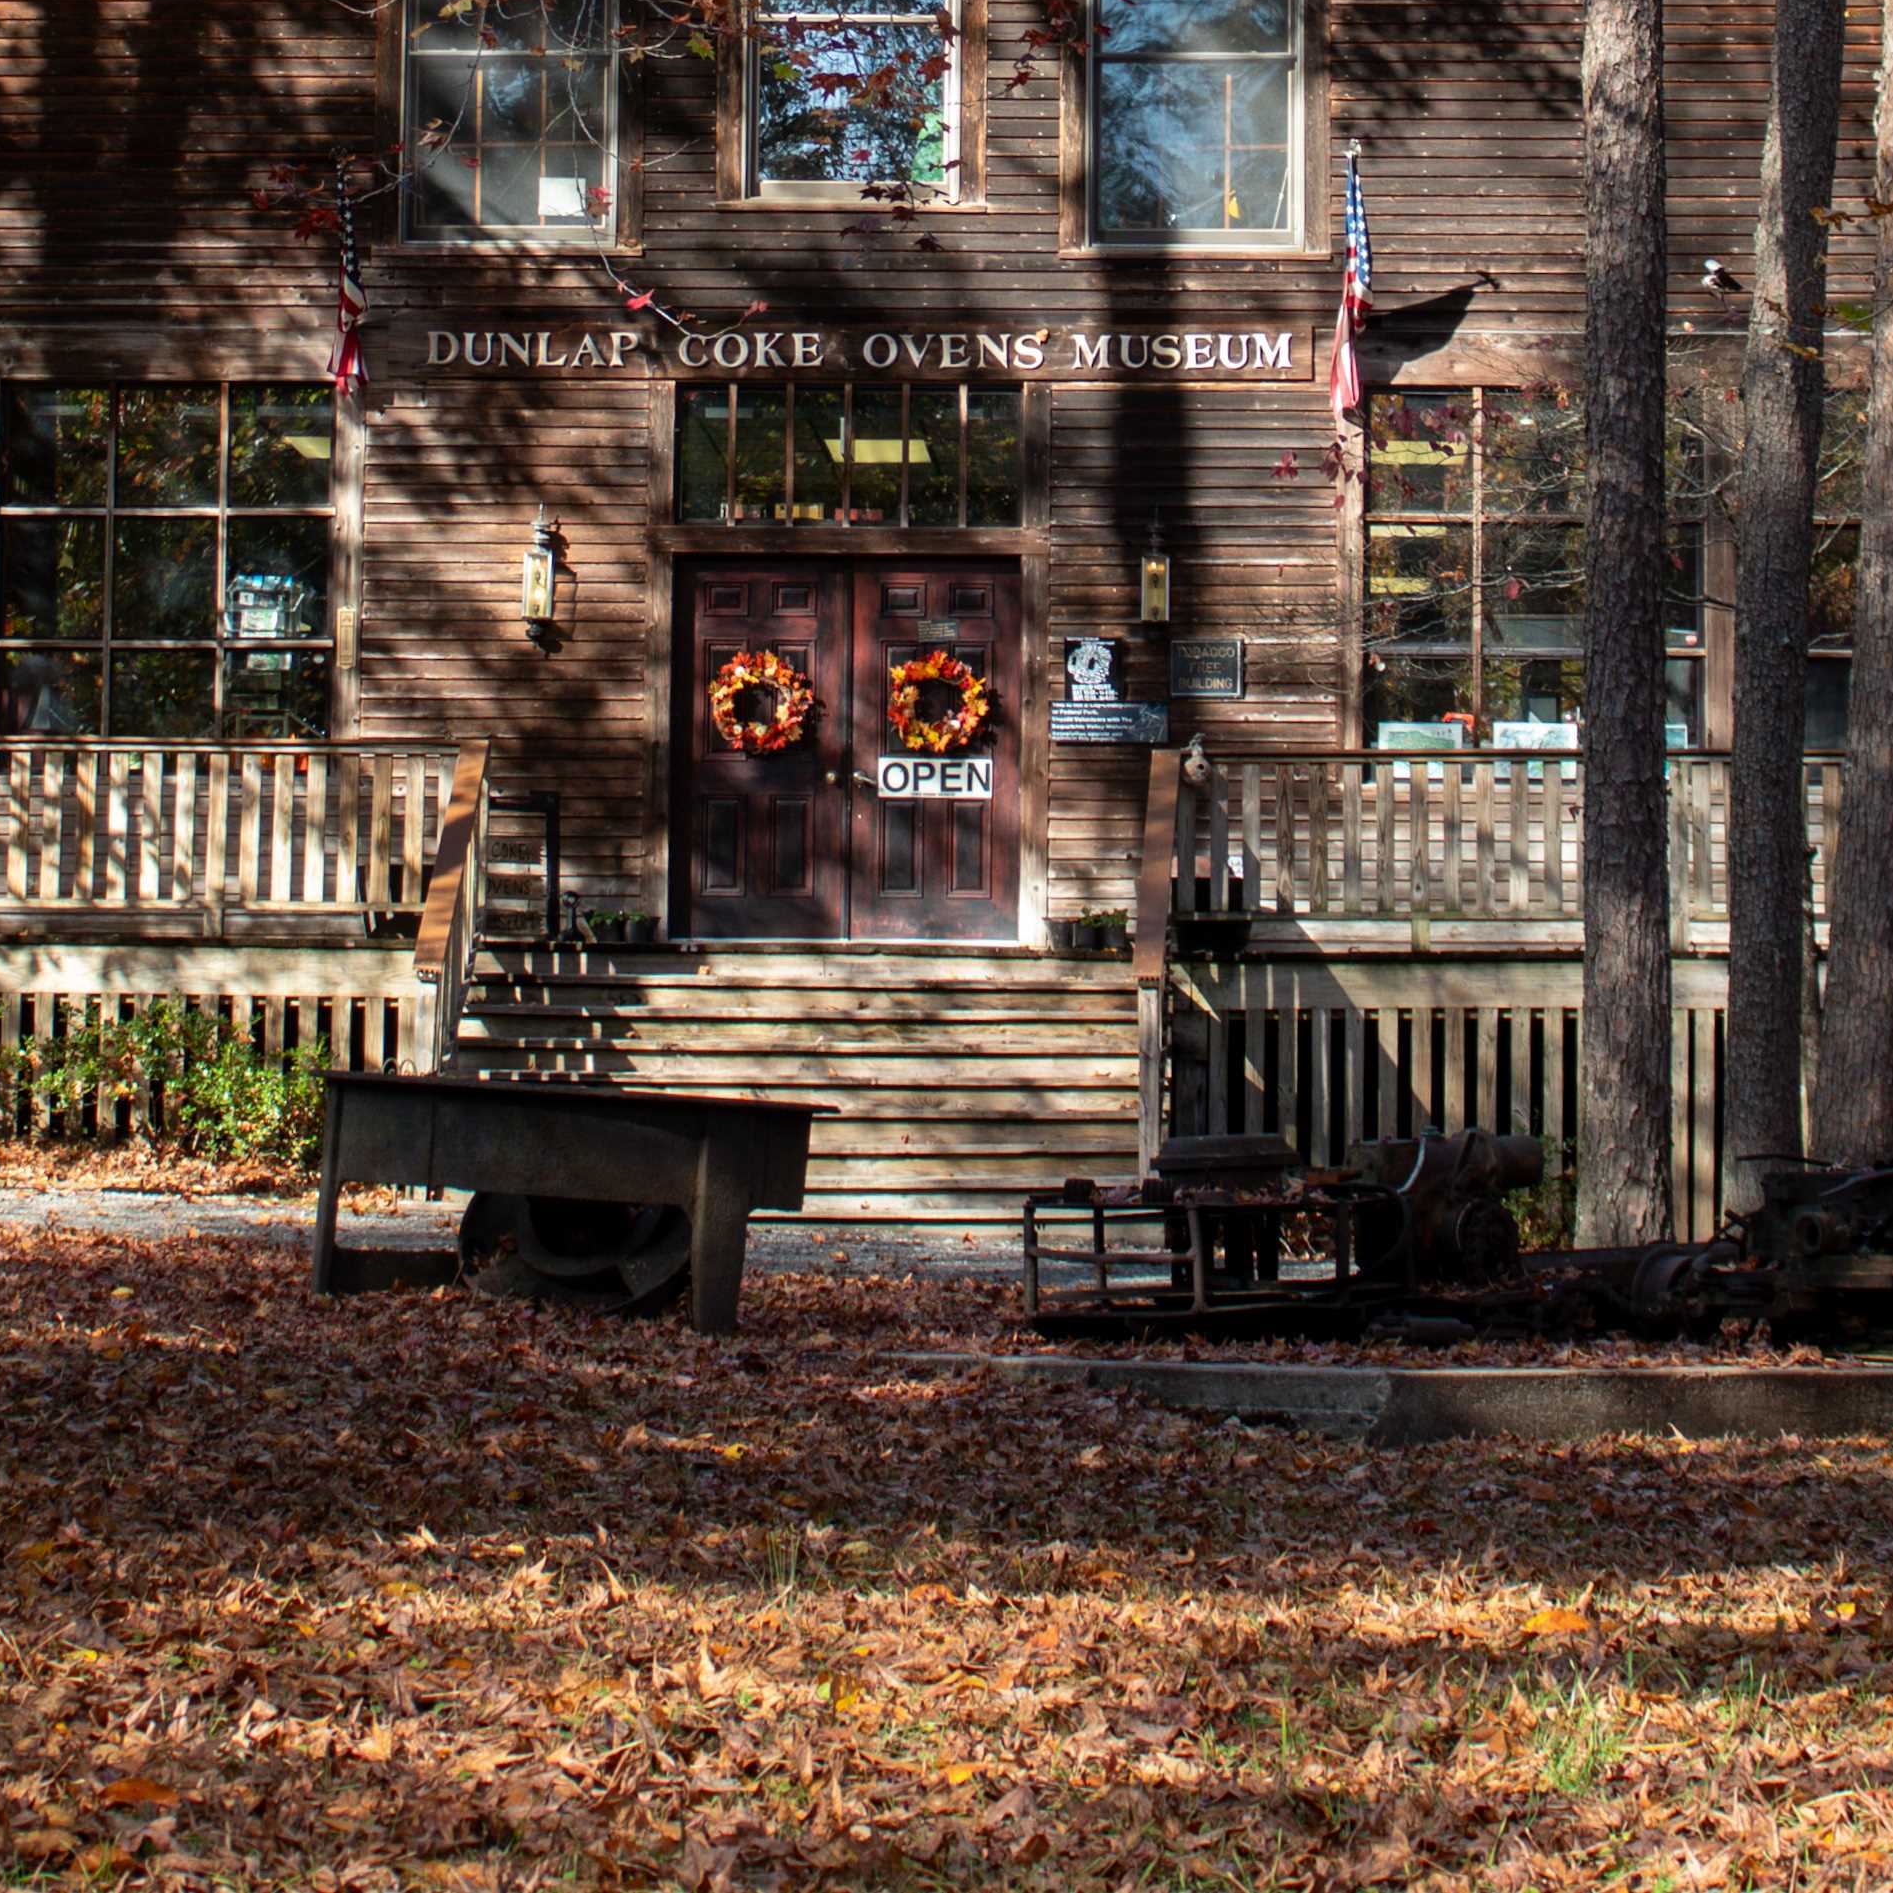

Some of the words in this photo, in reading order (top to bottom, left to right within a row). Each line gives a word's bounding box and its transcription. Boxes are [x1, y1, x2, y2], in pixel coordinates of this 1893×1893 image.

[426, 330, 639, 368] DUNLAP
[677, 331, 825, 368] COKE
[862, 332, 1046, 370] OVENS
[1071, 332, 1294, 370] MUSEUM
[1178, 645, 1236, 658] TOBACCO
[1188, 661, 1223, 674] FREE
[1178, 677, 1234, 690] BUILDING
[883, 761, 991, 793] OPEN
